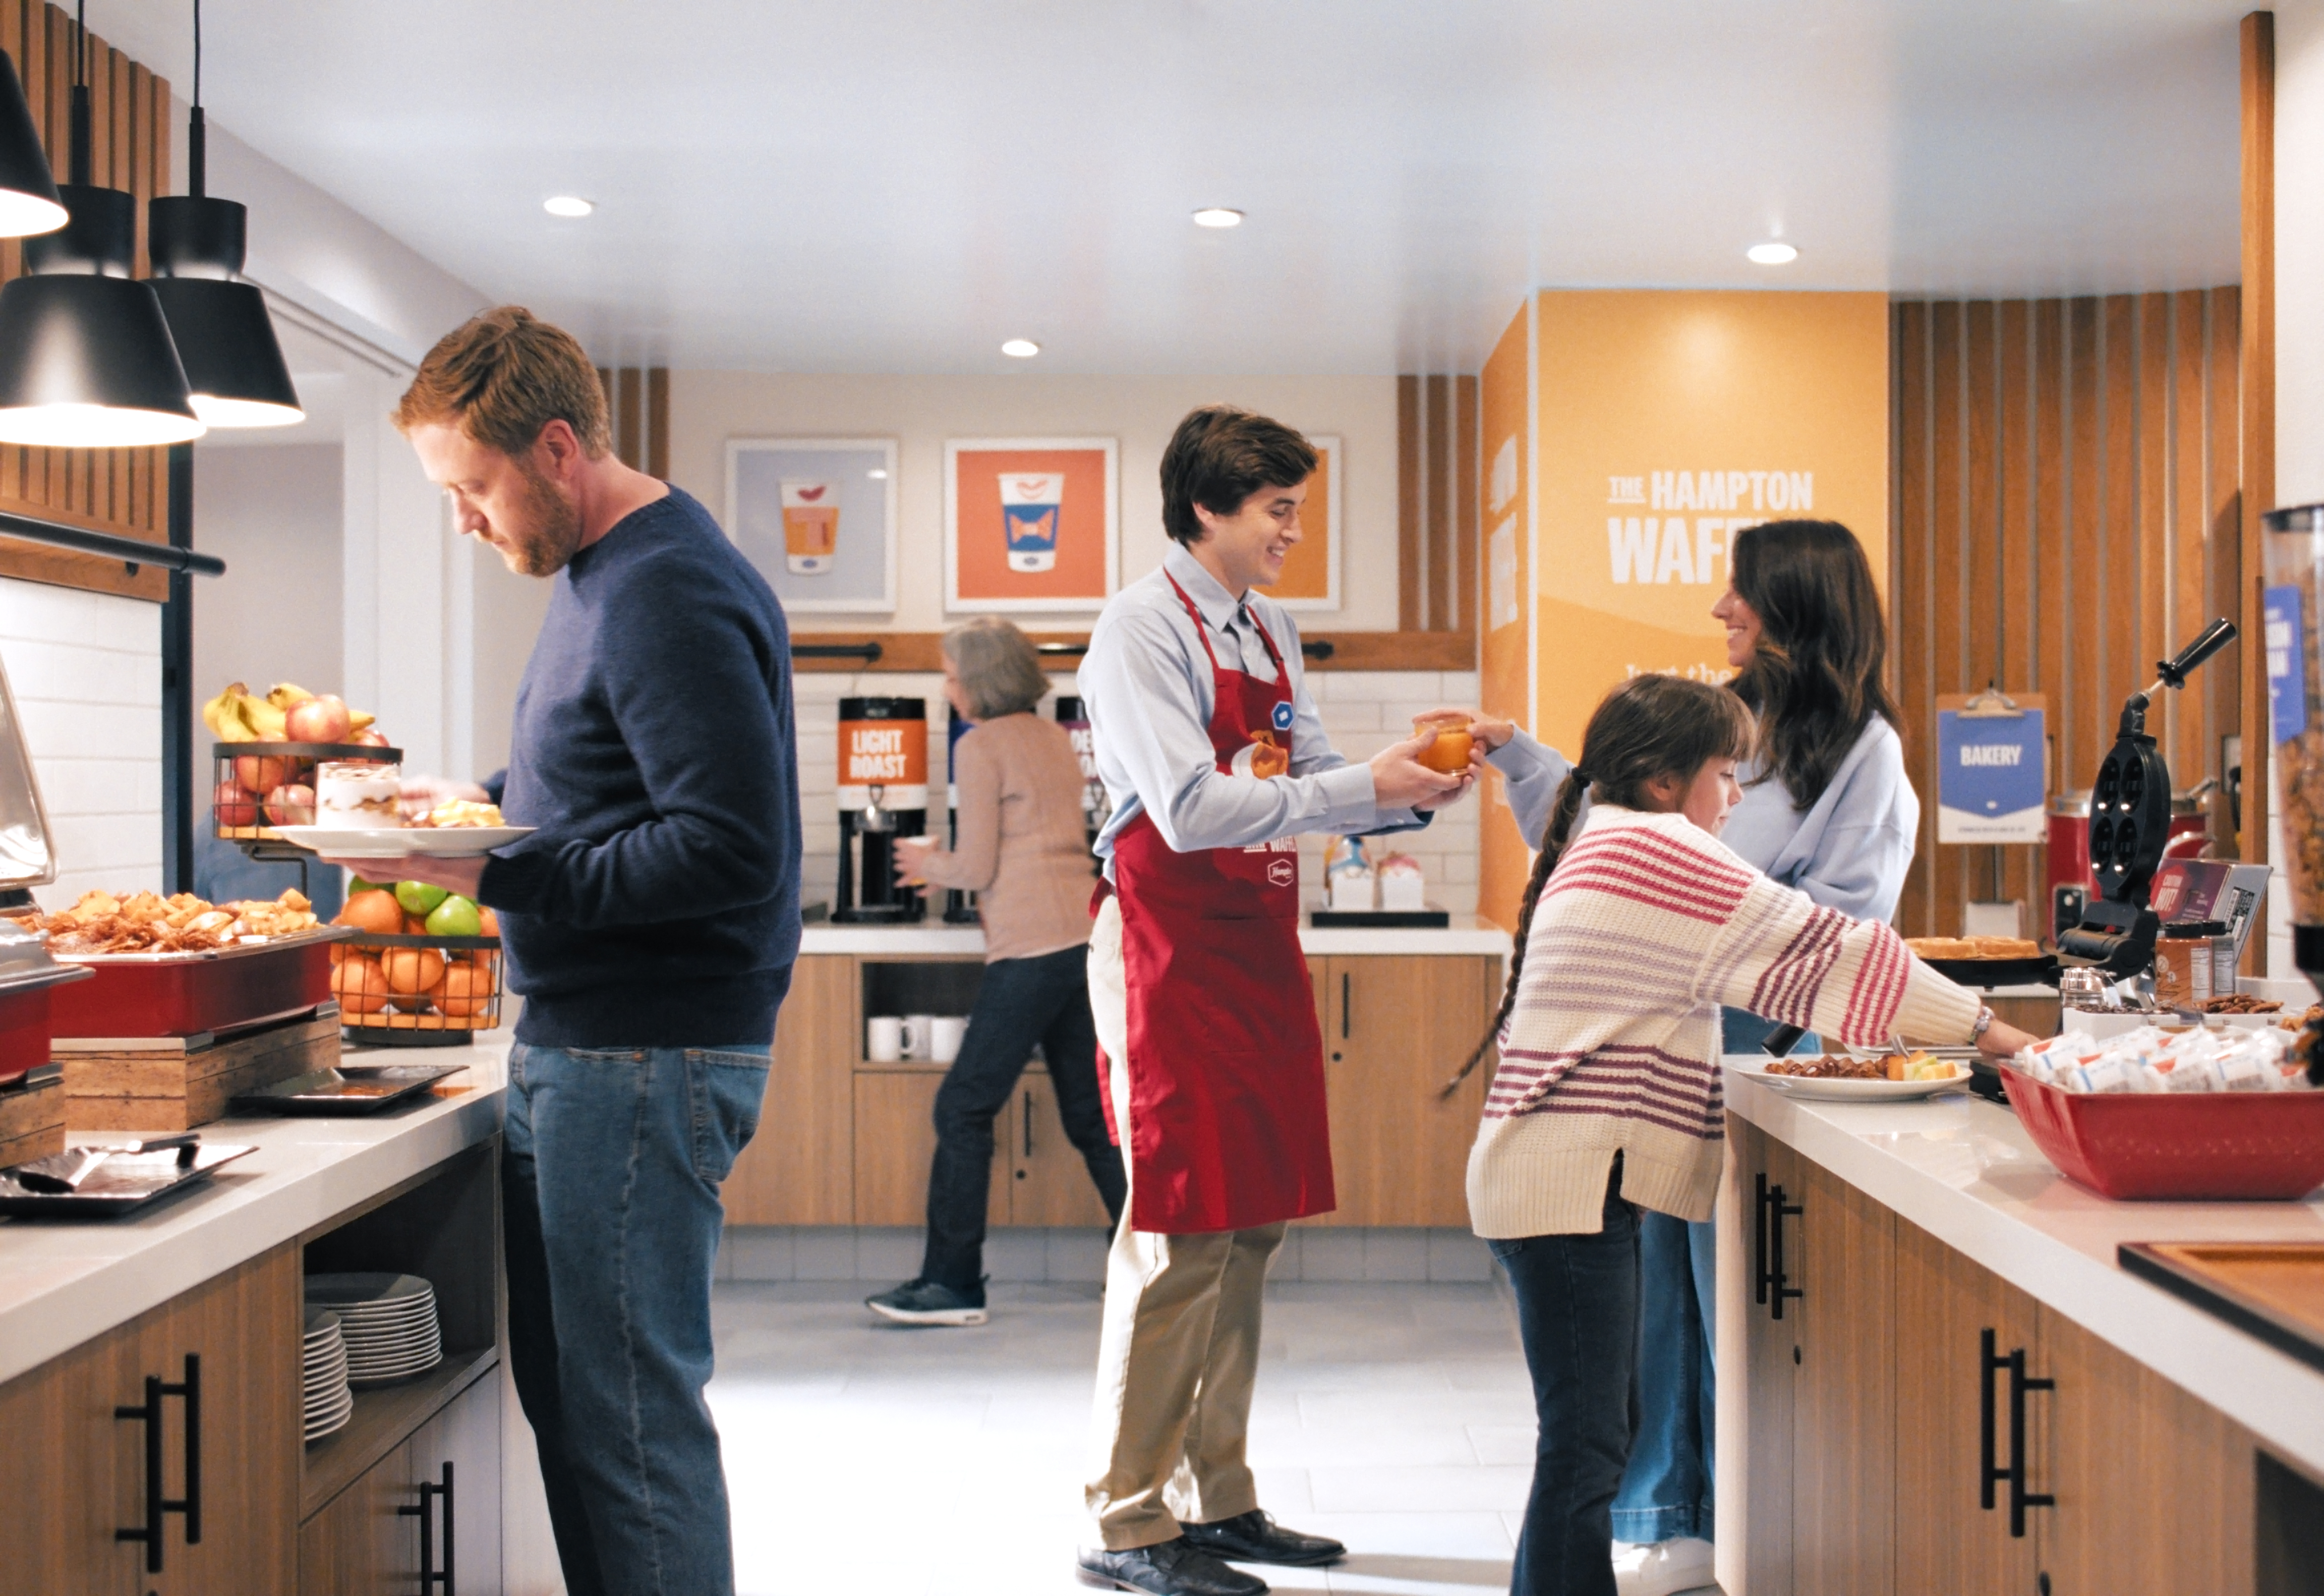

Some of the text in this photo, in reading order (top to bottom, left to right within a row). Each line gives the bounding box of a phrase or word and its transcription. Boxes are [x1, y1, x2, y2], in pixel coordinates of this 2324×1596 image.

[1608, 470, 1813, 510] THE HAMPTON
[851, 729, 904, 754] LIGHT
[849, 754, 907, 778] ROAST
[1960, 745, 2021, 766] BAKERY
